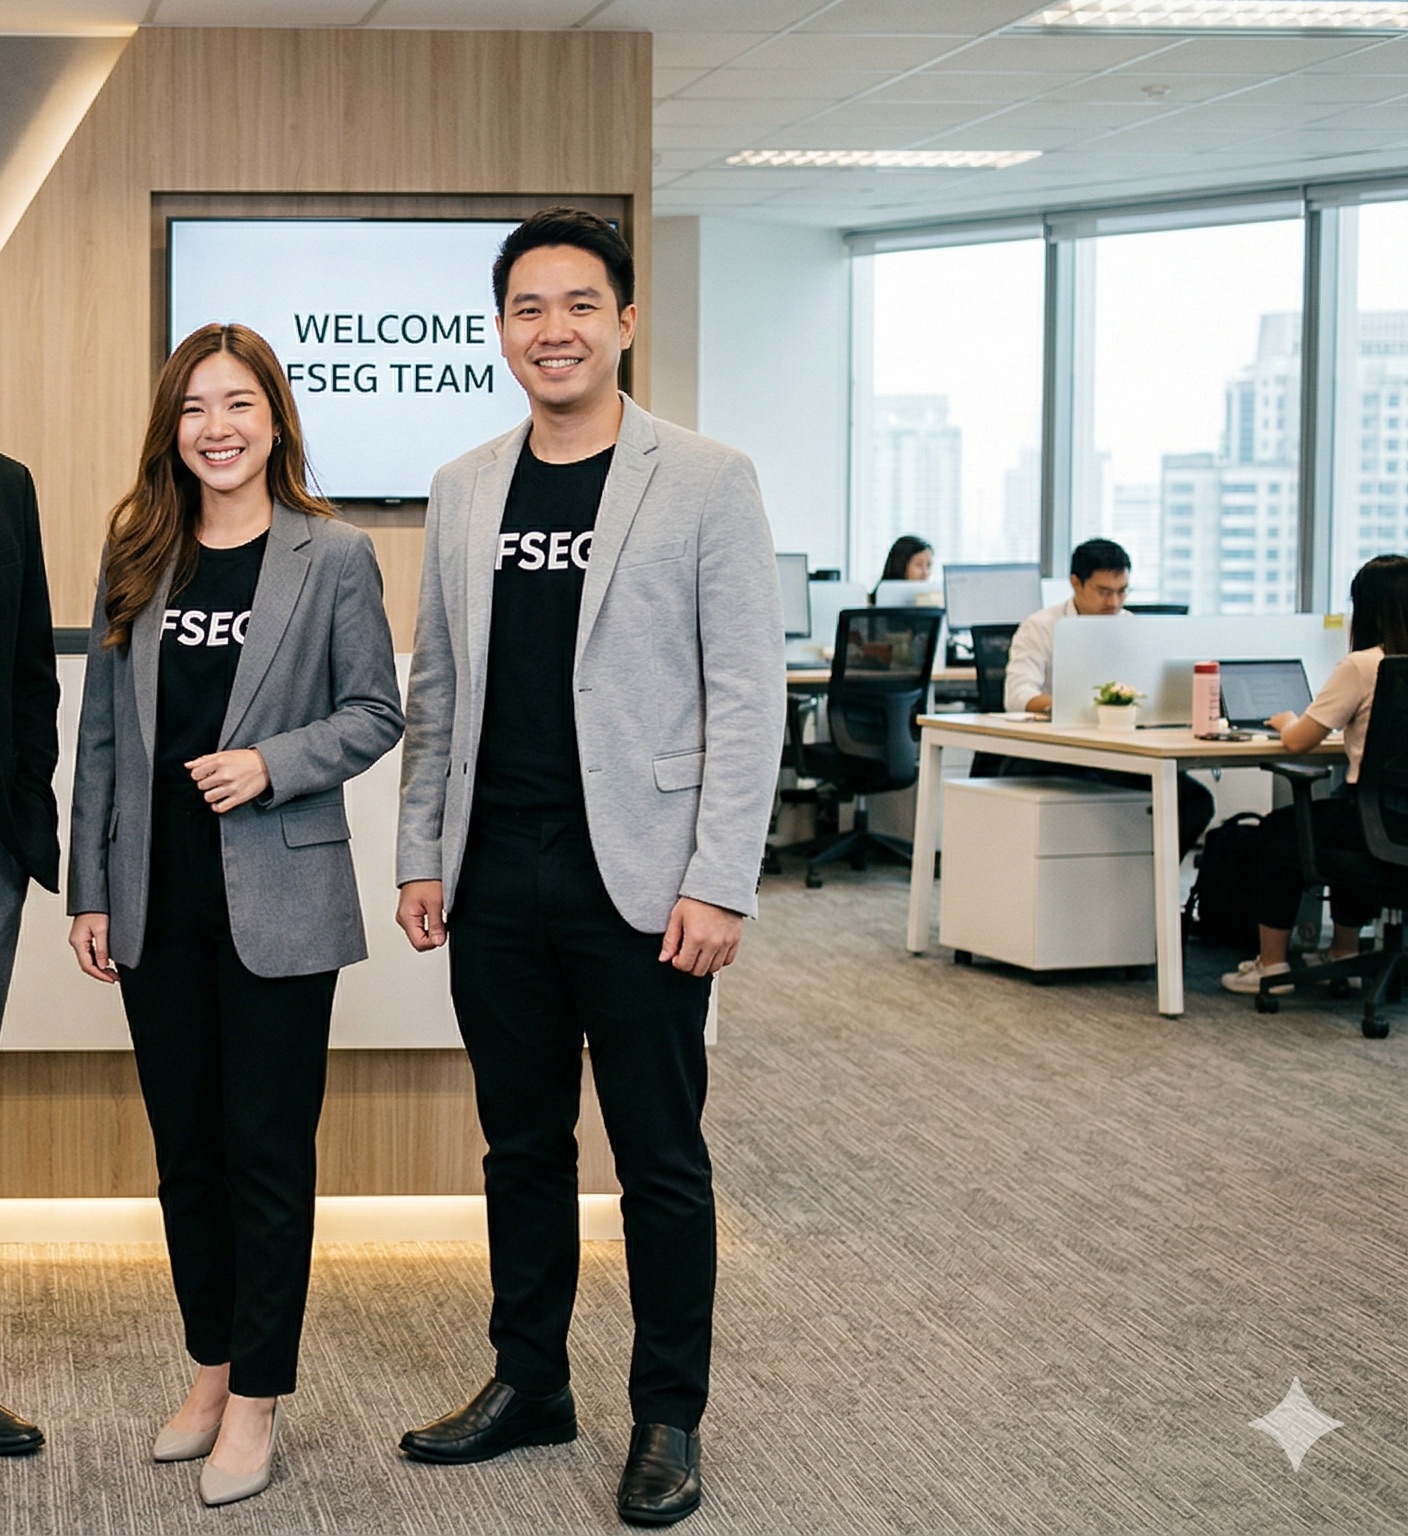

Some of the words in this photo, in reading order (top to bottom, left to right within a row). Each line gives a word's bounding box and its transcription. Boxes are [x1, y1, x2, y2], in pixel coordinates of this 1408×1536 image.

[294, 314, 485, 344] WELCOME
[287, 363, 377, 393] FSEG
[390, 364, 493, 393] TEAM
